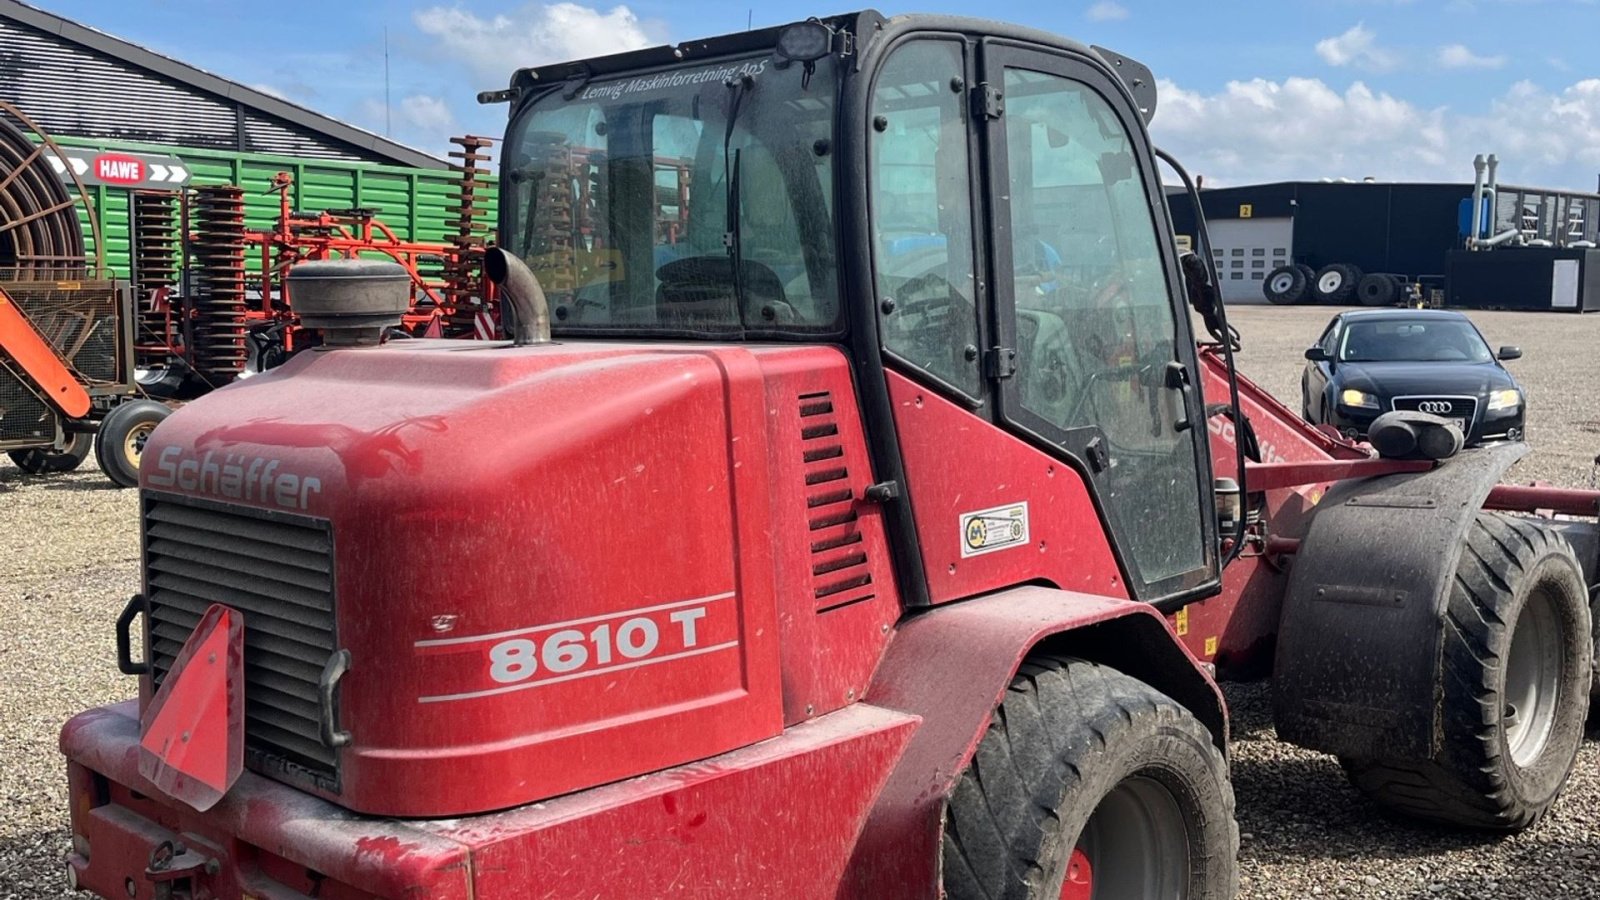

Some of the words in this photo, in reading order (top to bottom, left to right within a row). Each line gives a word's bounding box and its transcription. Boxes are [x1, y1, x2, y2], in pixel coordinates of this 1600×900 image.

[582, 81, 625, 100] Lemvig
[625, 65, 737, 94] Maskinforretning
[100, 159, 139, 180] HAWE
[147, 446, 321, 509] Schäffer
[489, 617, 659, 683] 8610
[669, 606, 706, 648] T
